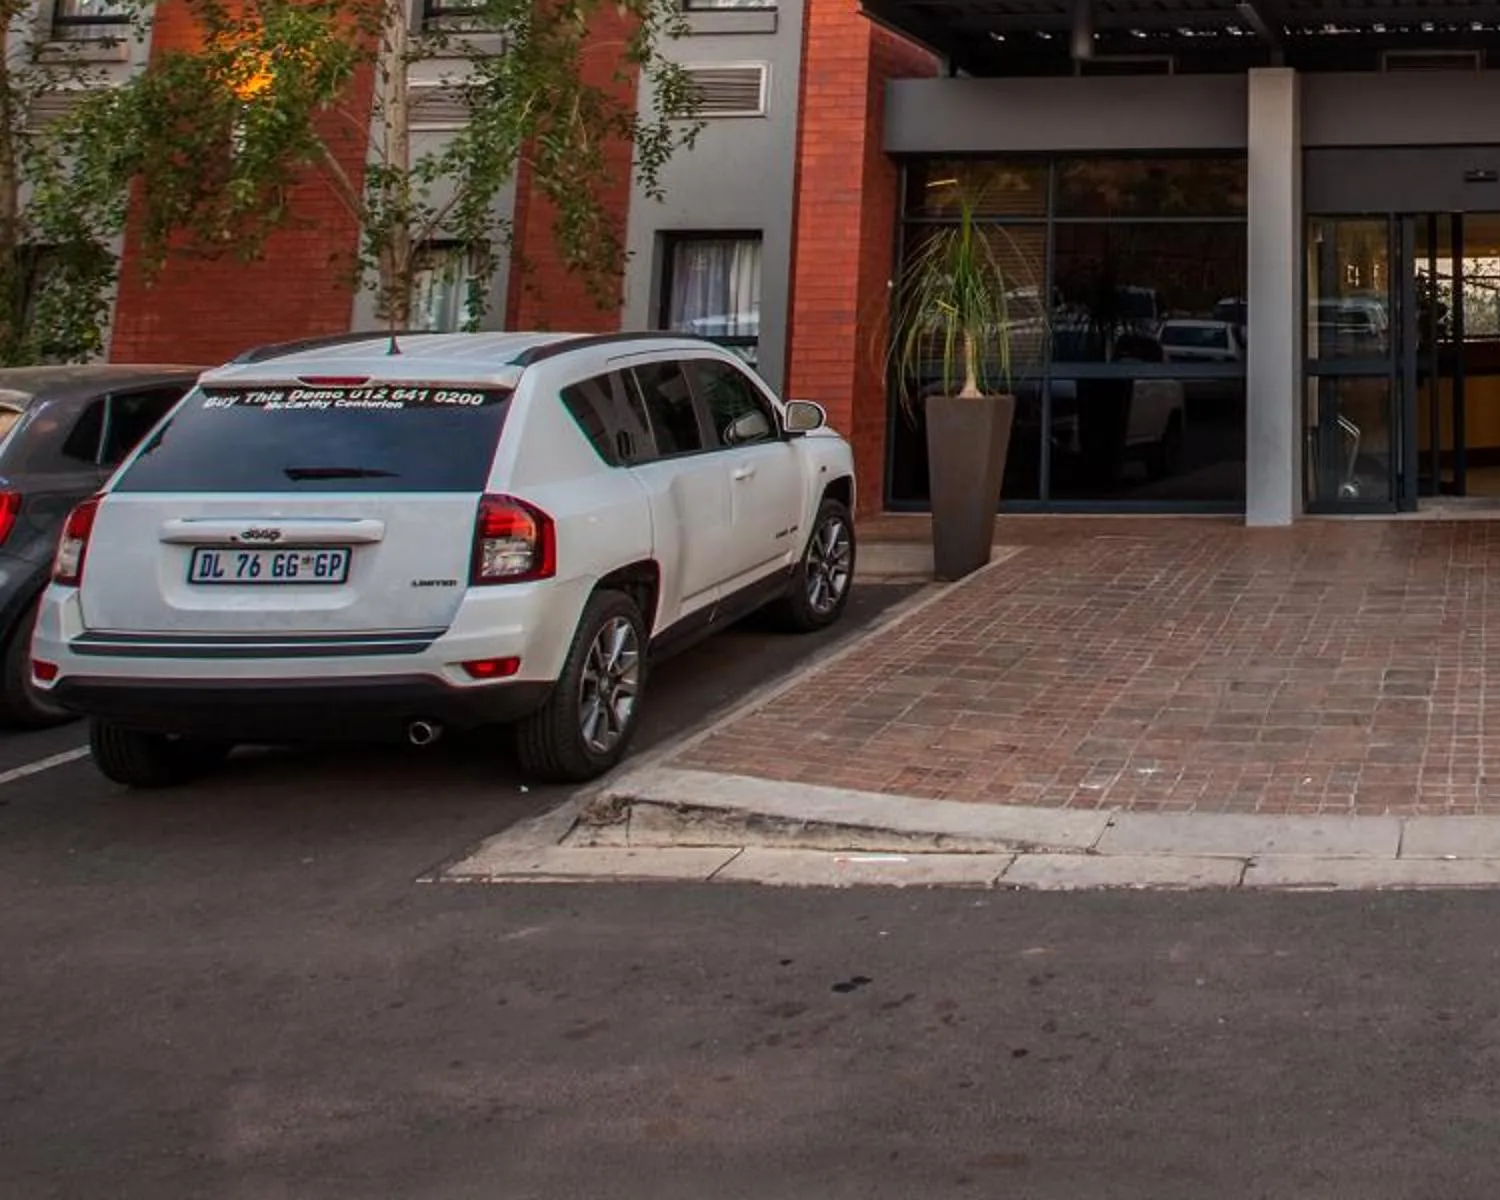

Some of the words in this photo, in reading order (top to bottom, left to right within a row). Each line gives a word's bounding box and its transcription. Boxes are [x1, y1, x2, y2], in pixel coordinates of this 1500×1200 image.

[203, 396, 240, 409] Buy
[244, 391, 285, 403] This
[287, 389, 345, 401] Demo
[348, 388, 389, 400] 012
[433, 390, 485, 406] 0200
[199, 554, 225, 578] DL
[236, 554, 262, 578] 76
[272, 554, 299, 578] GG
[314, 554, 342, 578] GP
